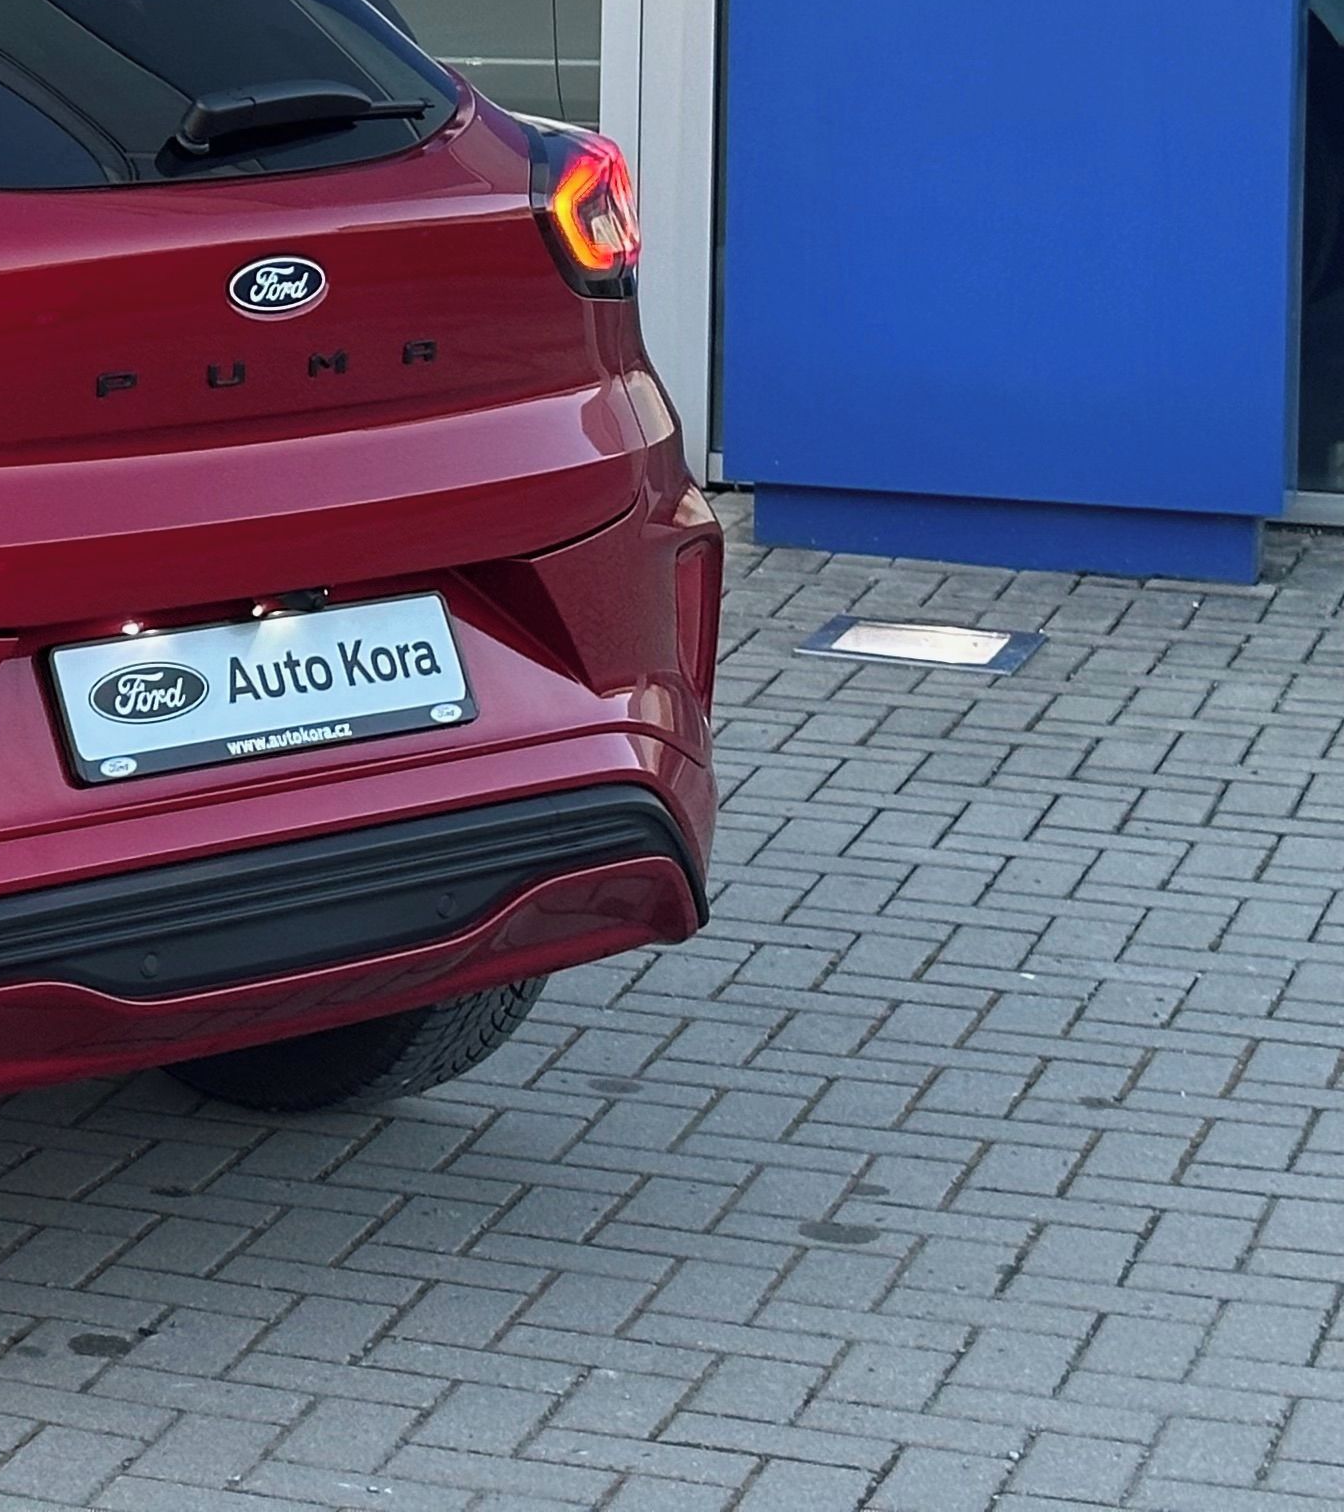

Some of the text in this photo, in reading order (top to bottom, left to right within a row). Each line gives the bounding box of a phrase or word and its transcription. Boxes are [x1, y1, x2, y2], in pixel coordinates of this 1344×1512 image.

[250, 266, 309, 303] Ford
[95, 339, 438, 398] PUMA
[115, 638, 441, 716] Ford Auto Kora
[227, 721, 353, 756] www.autokora.cz
